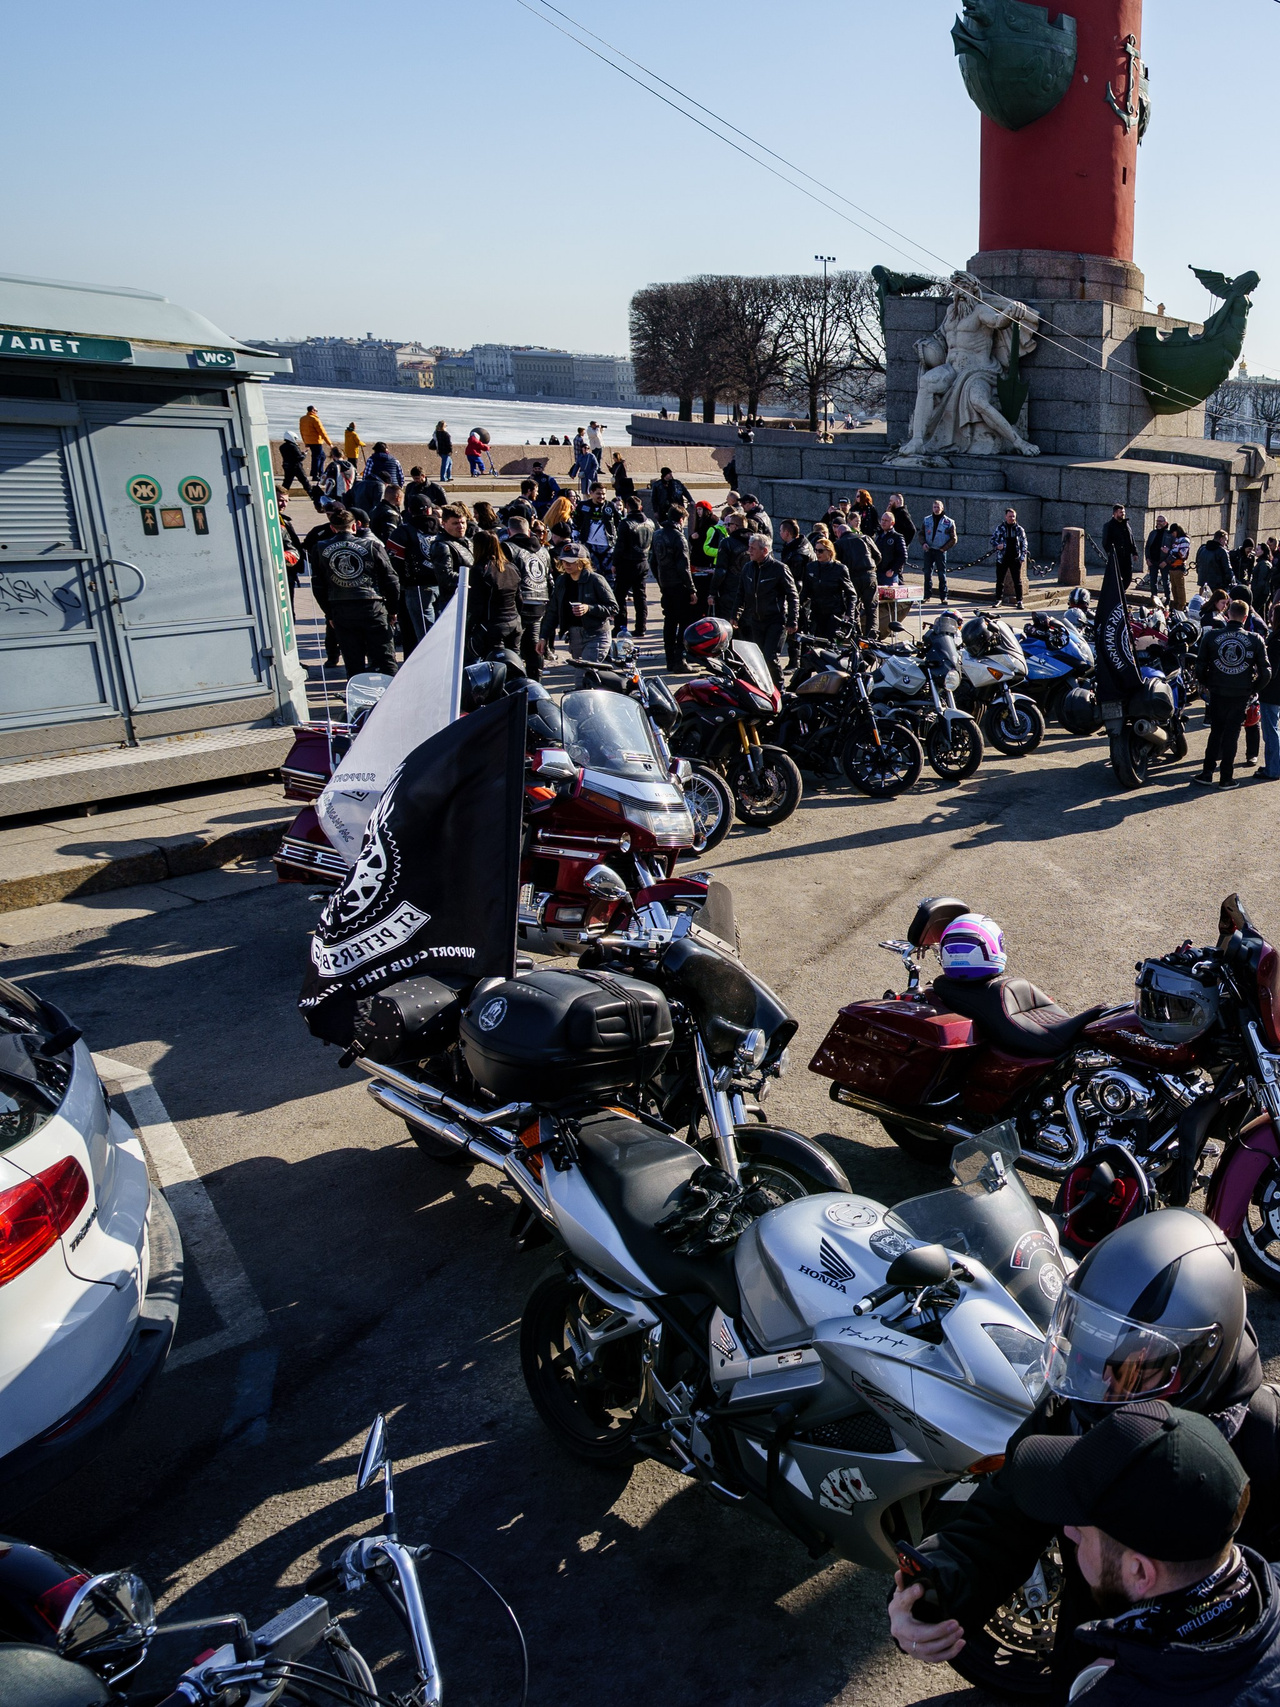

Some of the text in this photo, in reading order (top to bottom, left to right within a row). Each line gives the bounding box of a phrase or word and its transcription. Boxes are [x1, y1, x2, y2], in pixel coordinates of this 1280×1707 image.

[0, 336, 80, 354] АЛЕТ
[202, 352, 227, 364] WC
[135, 484, 155, 498] Ж
[188, 485, 204, 498] М
[263, 471, 291, 627] TOILET
[1105, 625, 1125, 670] NORMANS
[798, 1265, 847, 1294] HONDA
[1176, 1598, 1233, 1637] TRELLEBORG
